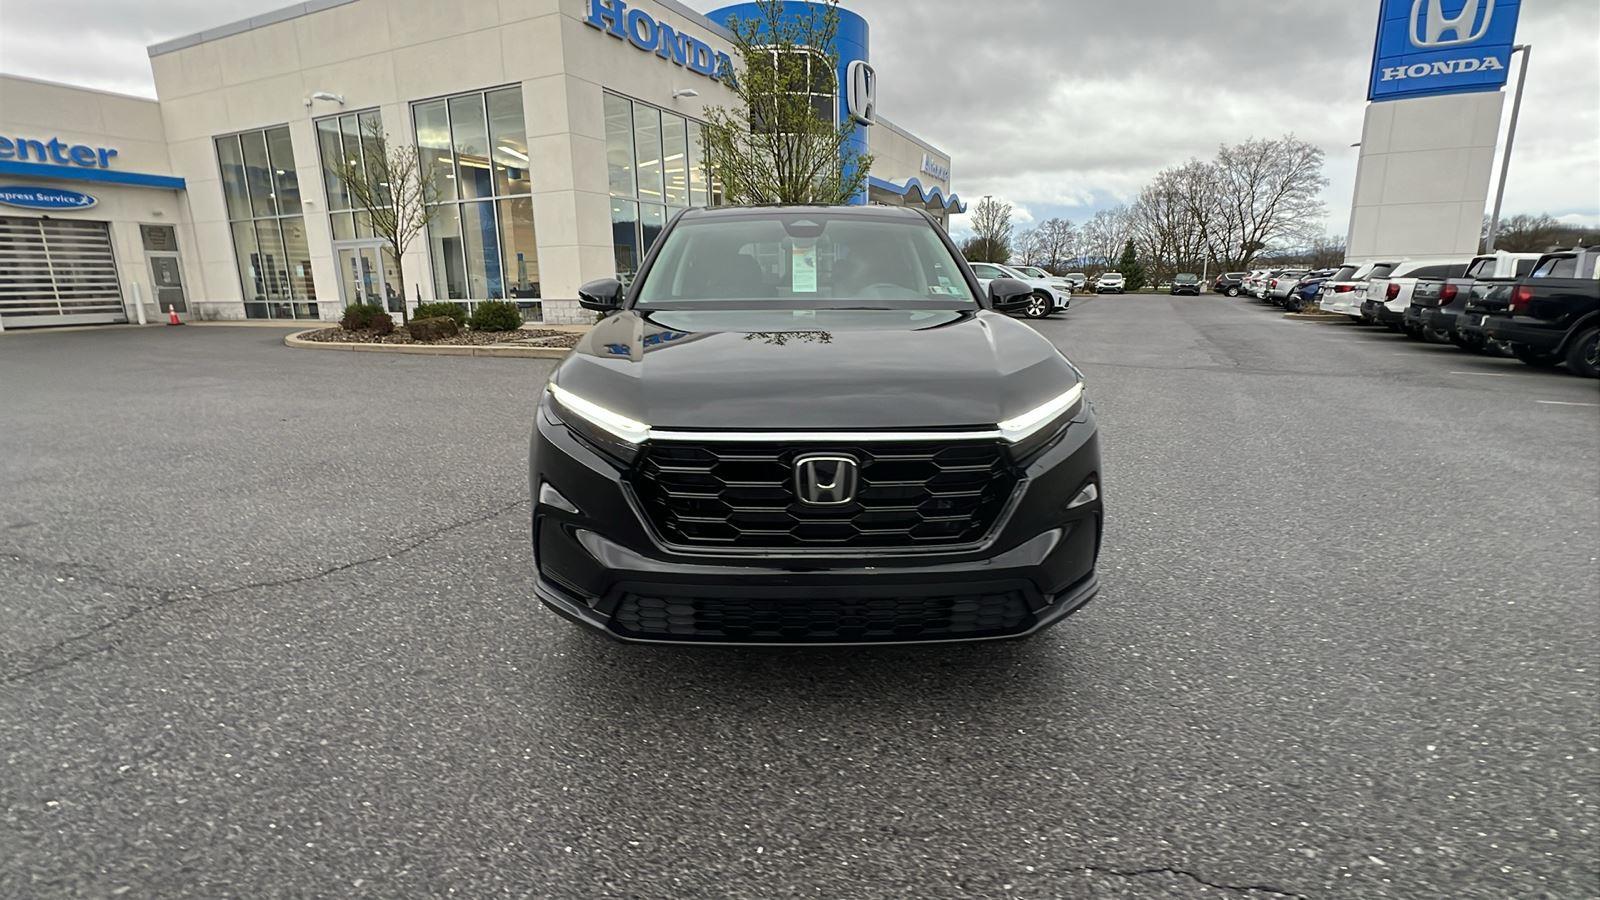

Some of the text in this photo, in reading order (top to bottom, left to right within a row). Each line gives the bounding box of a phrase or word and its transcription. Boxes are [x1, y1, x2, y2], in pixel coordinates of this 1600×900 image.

[583, 0, 738, 87] HONDA
[1380, 56, 1504, 81] HONDA
[36, 193, 76, 203] Service
